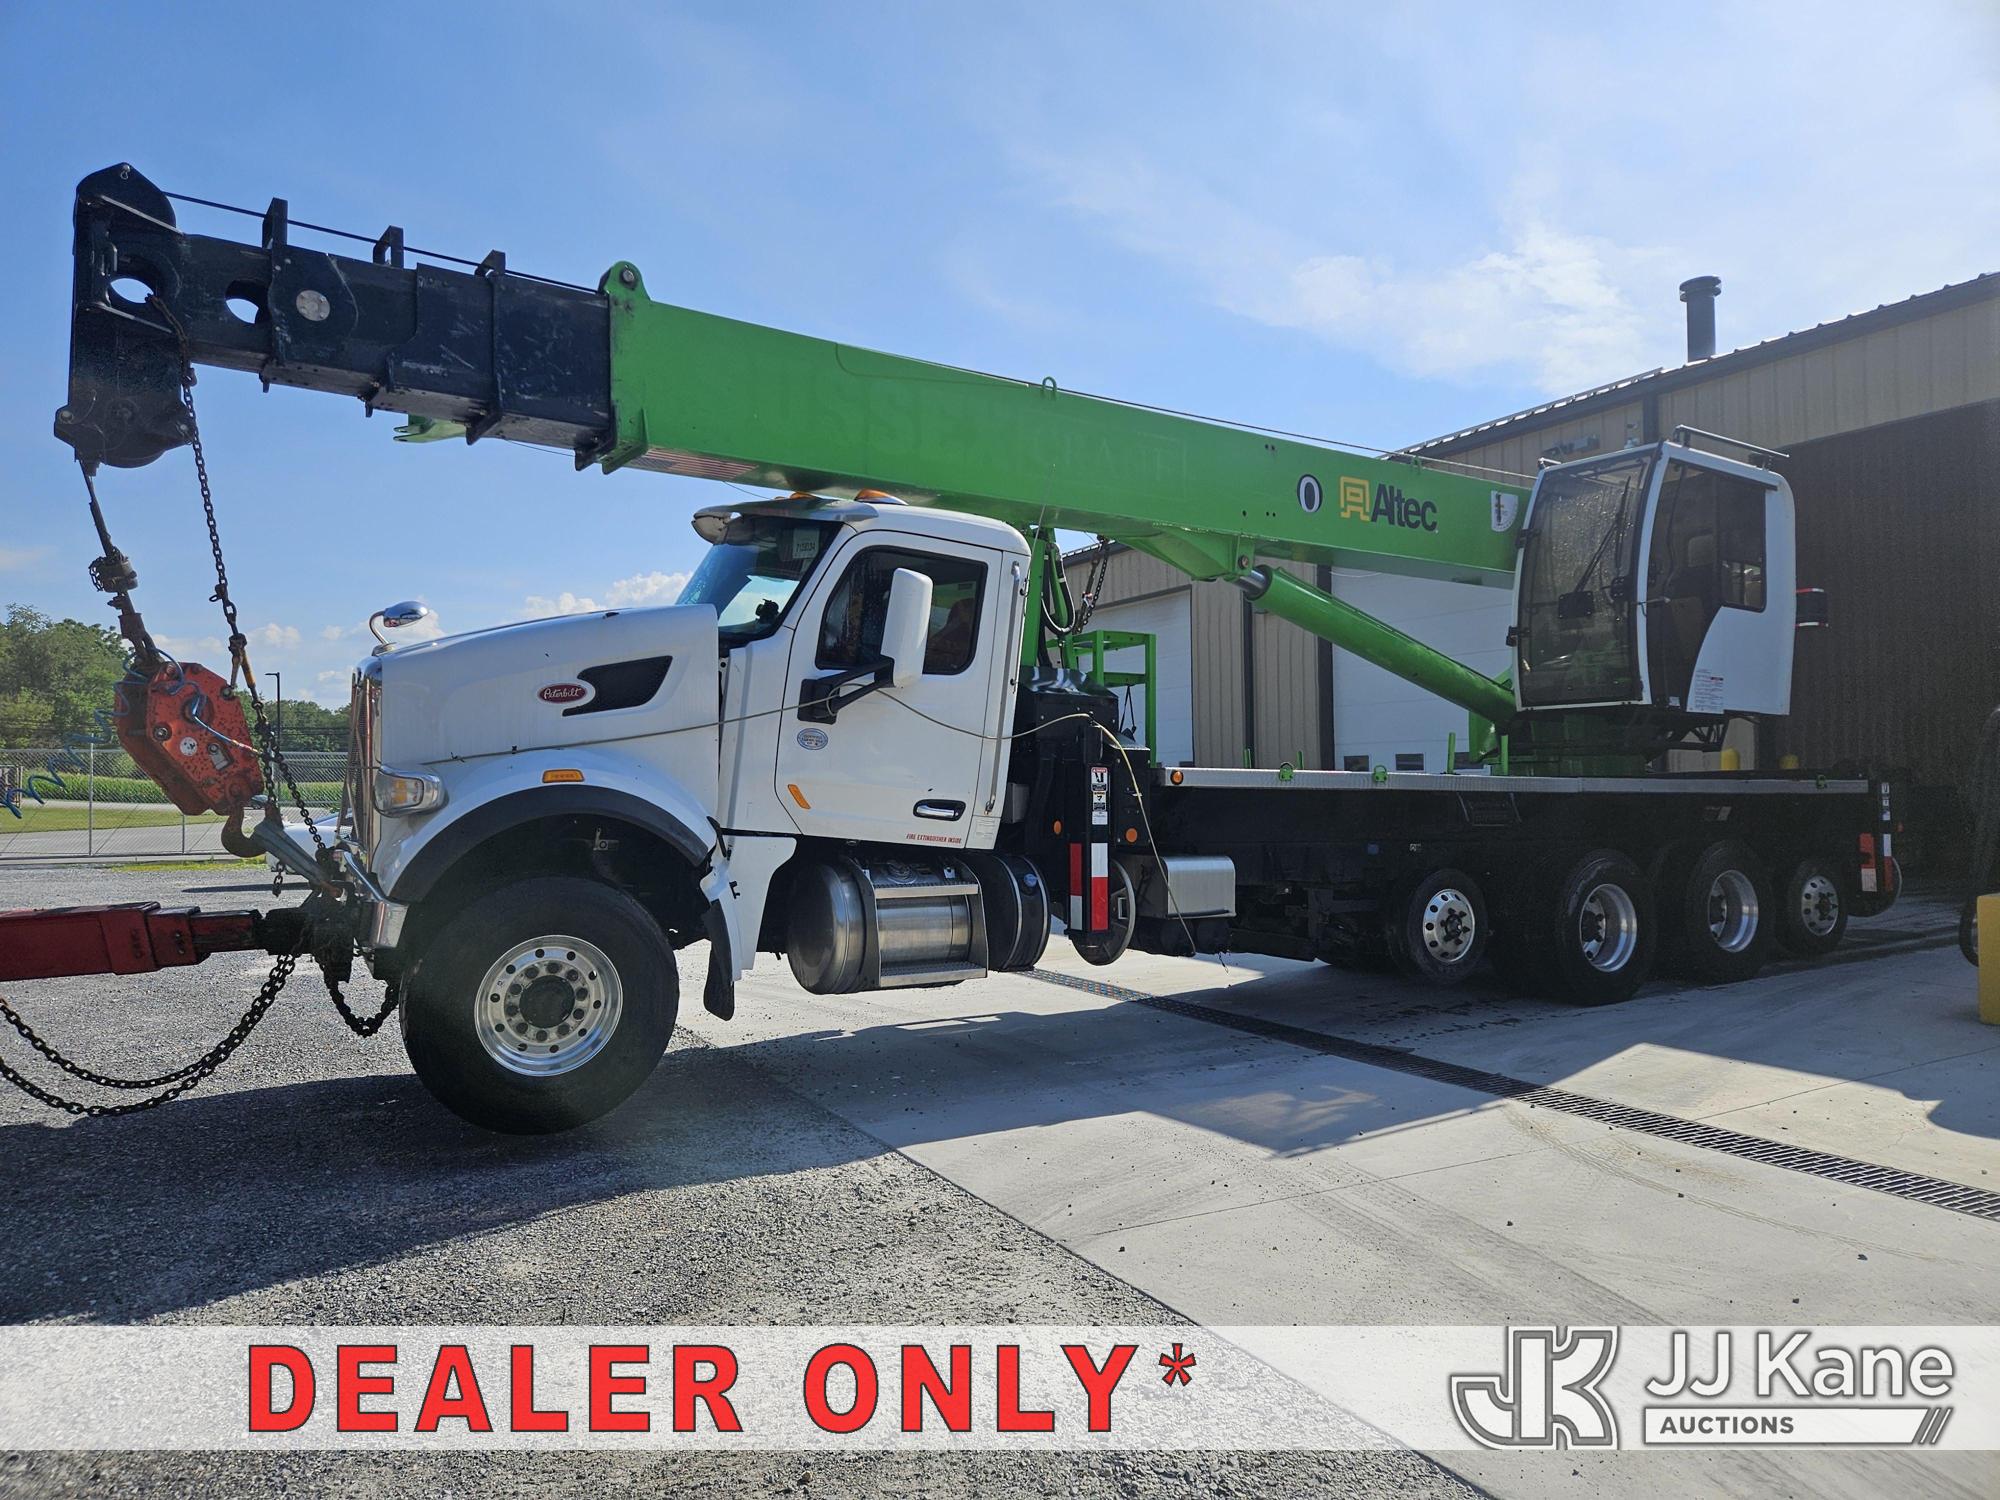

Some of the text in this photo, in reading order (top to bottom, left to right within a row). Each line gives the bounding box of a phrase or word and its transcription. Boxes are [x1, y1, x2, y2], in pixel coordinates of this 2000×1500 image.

[1370, 482, 1438, 532] Altec
[543, 688, 582, 699] Peterbilt
[917, 834, 947, 842] EXTINGUISHER
[947, 836, 961, 844] INSIDE
